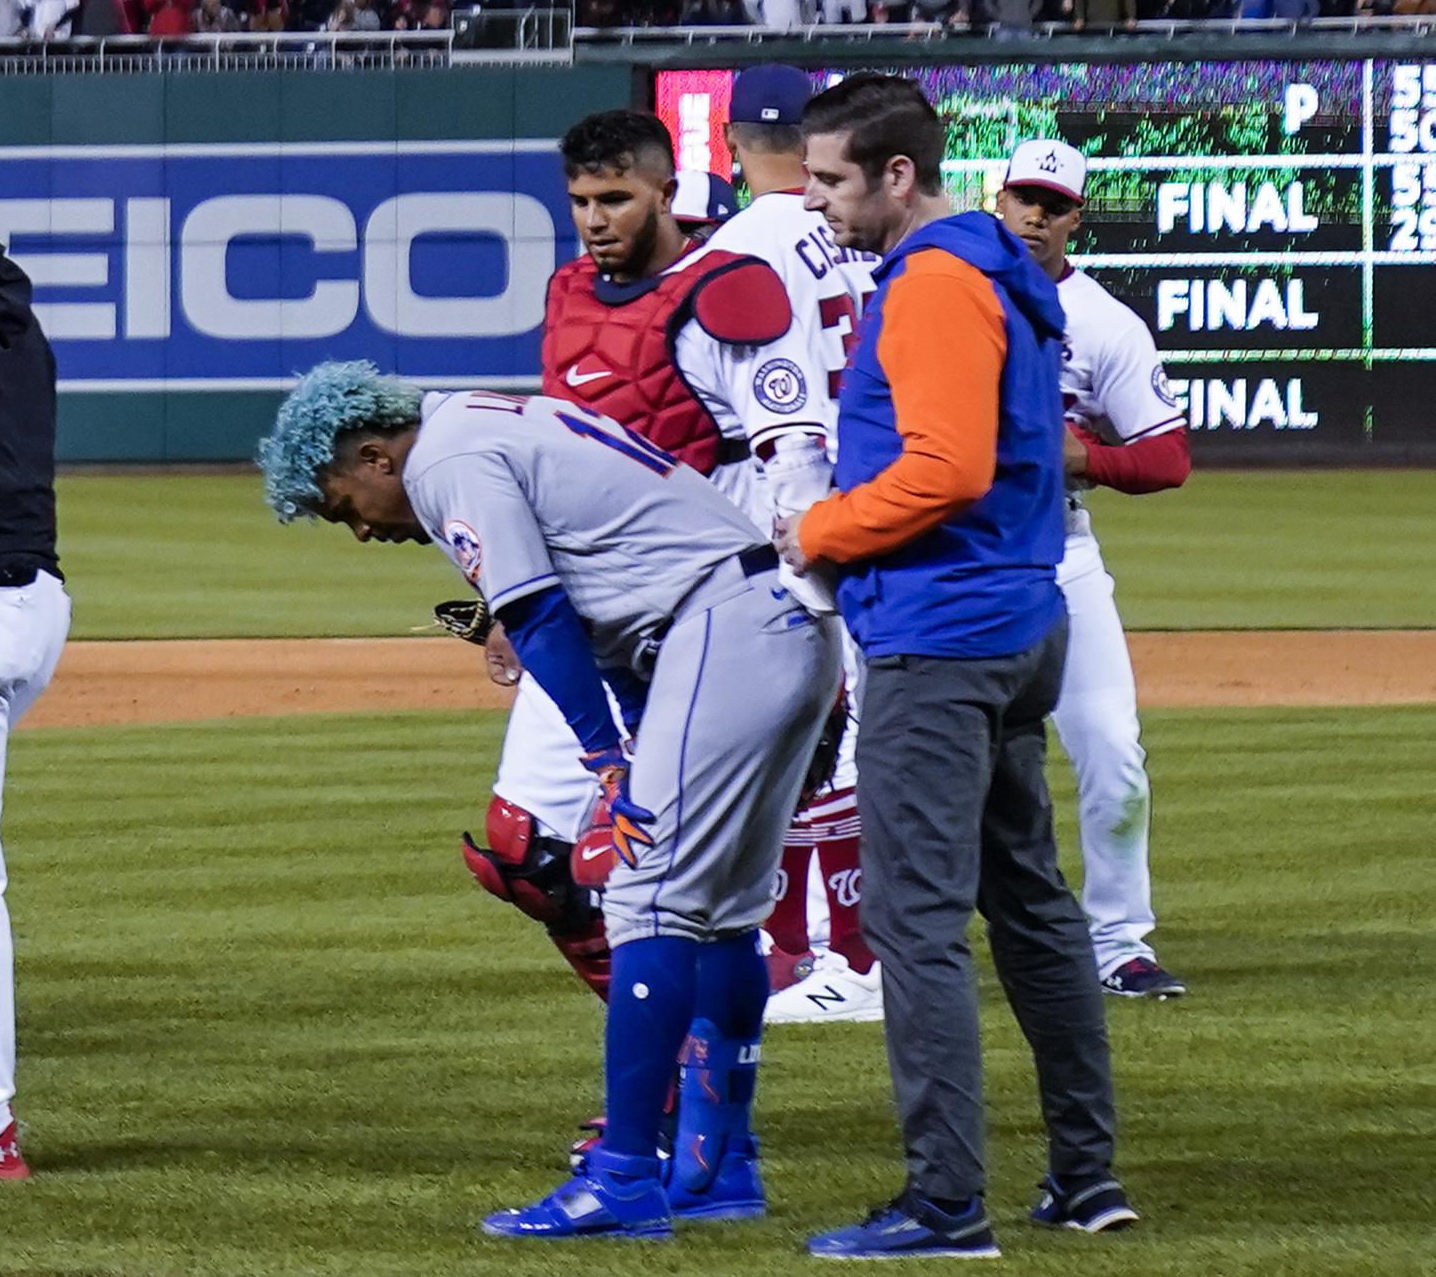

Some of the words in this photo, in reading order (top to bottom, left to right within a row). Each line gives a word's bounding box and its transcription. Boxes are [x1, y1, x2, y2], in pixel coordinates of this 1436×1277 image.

[1284, 83, 1319, 136] P
[1158, 181, 1319, 234] FINAL
[1158, 278, 1319, 331] FINAL
